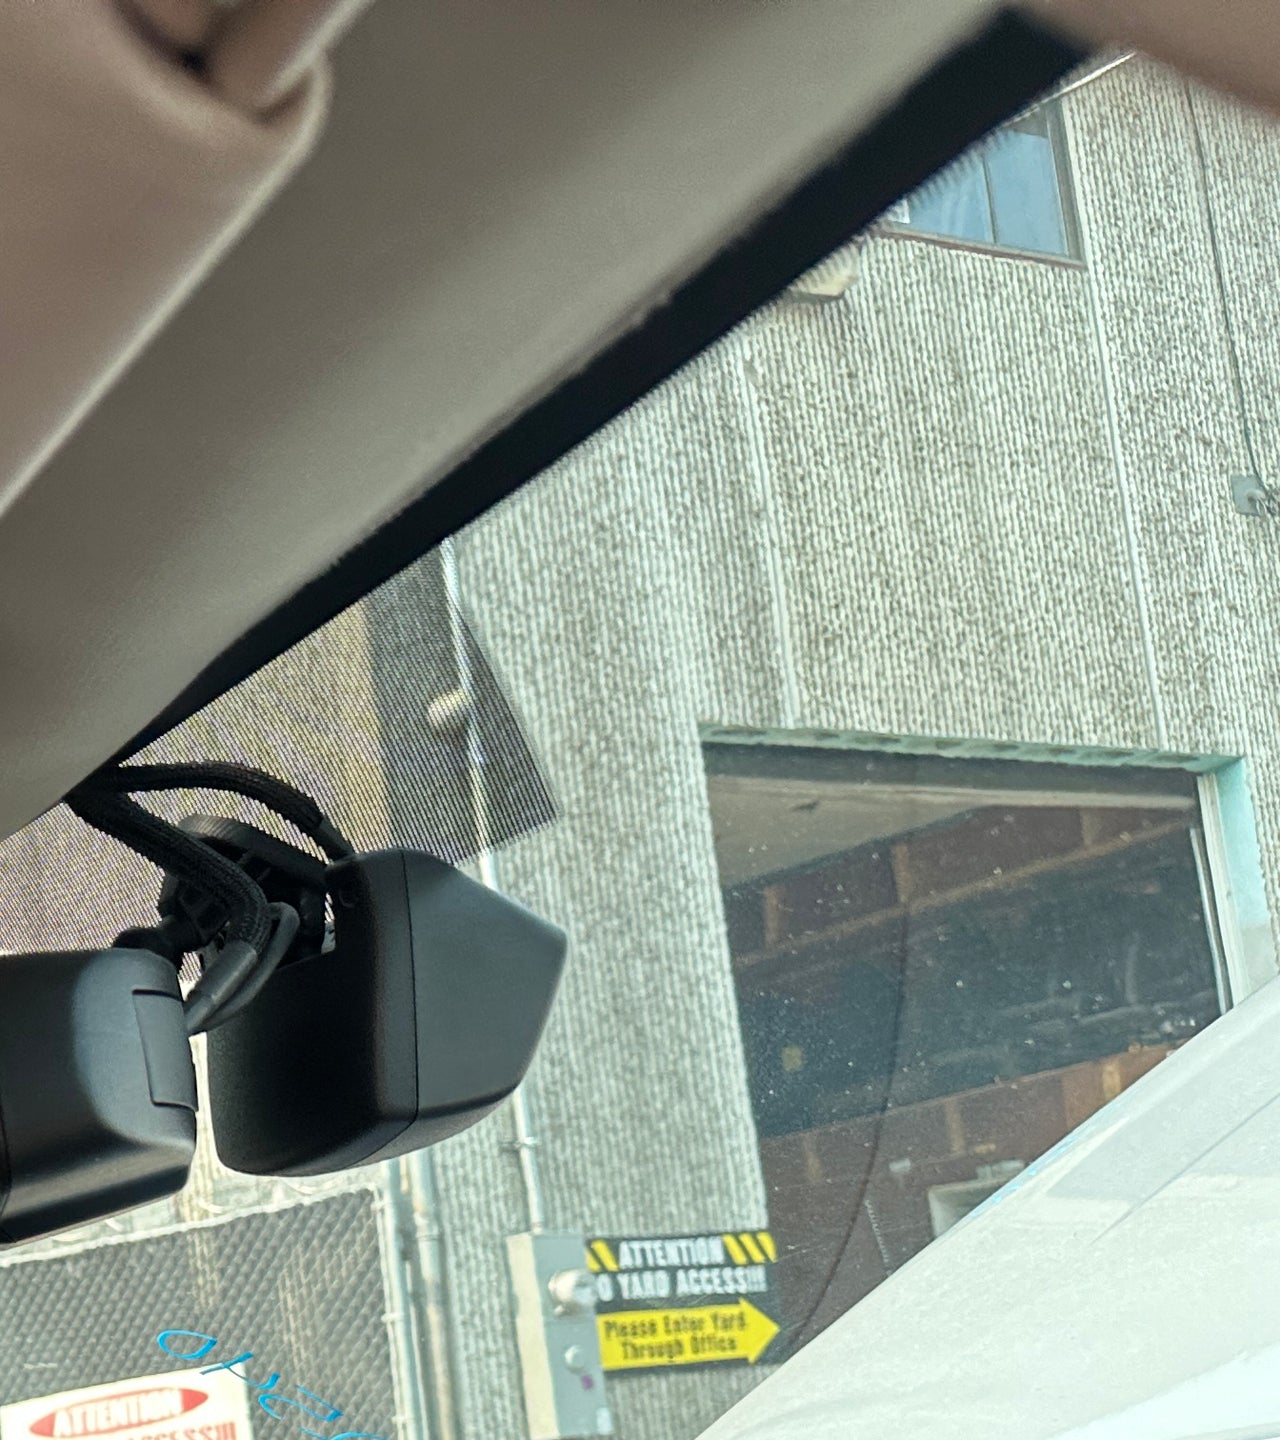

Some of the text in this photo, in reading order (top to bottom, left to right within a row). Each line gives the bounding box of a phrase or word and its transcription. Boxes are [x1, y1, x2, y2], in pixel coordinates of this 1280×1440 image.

[618, 1235, 726, 1269] ATTENTION
[617, 1269, 671, 1299] YARD
[676, 1264, 768, 1295] ACCESS!!!
[604, 1311, 747, 1340] Please Enter Yard
[621, 1332, 738, 1361] Through Office
[52, 1388, 185, 1439] ATTENTION
